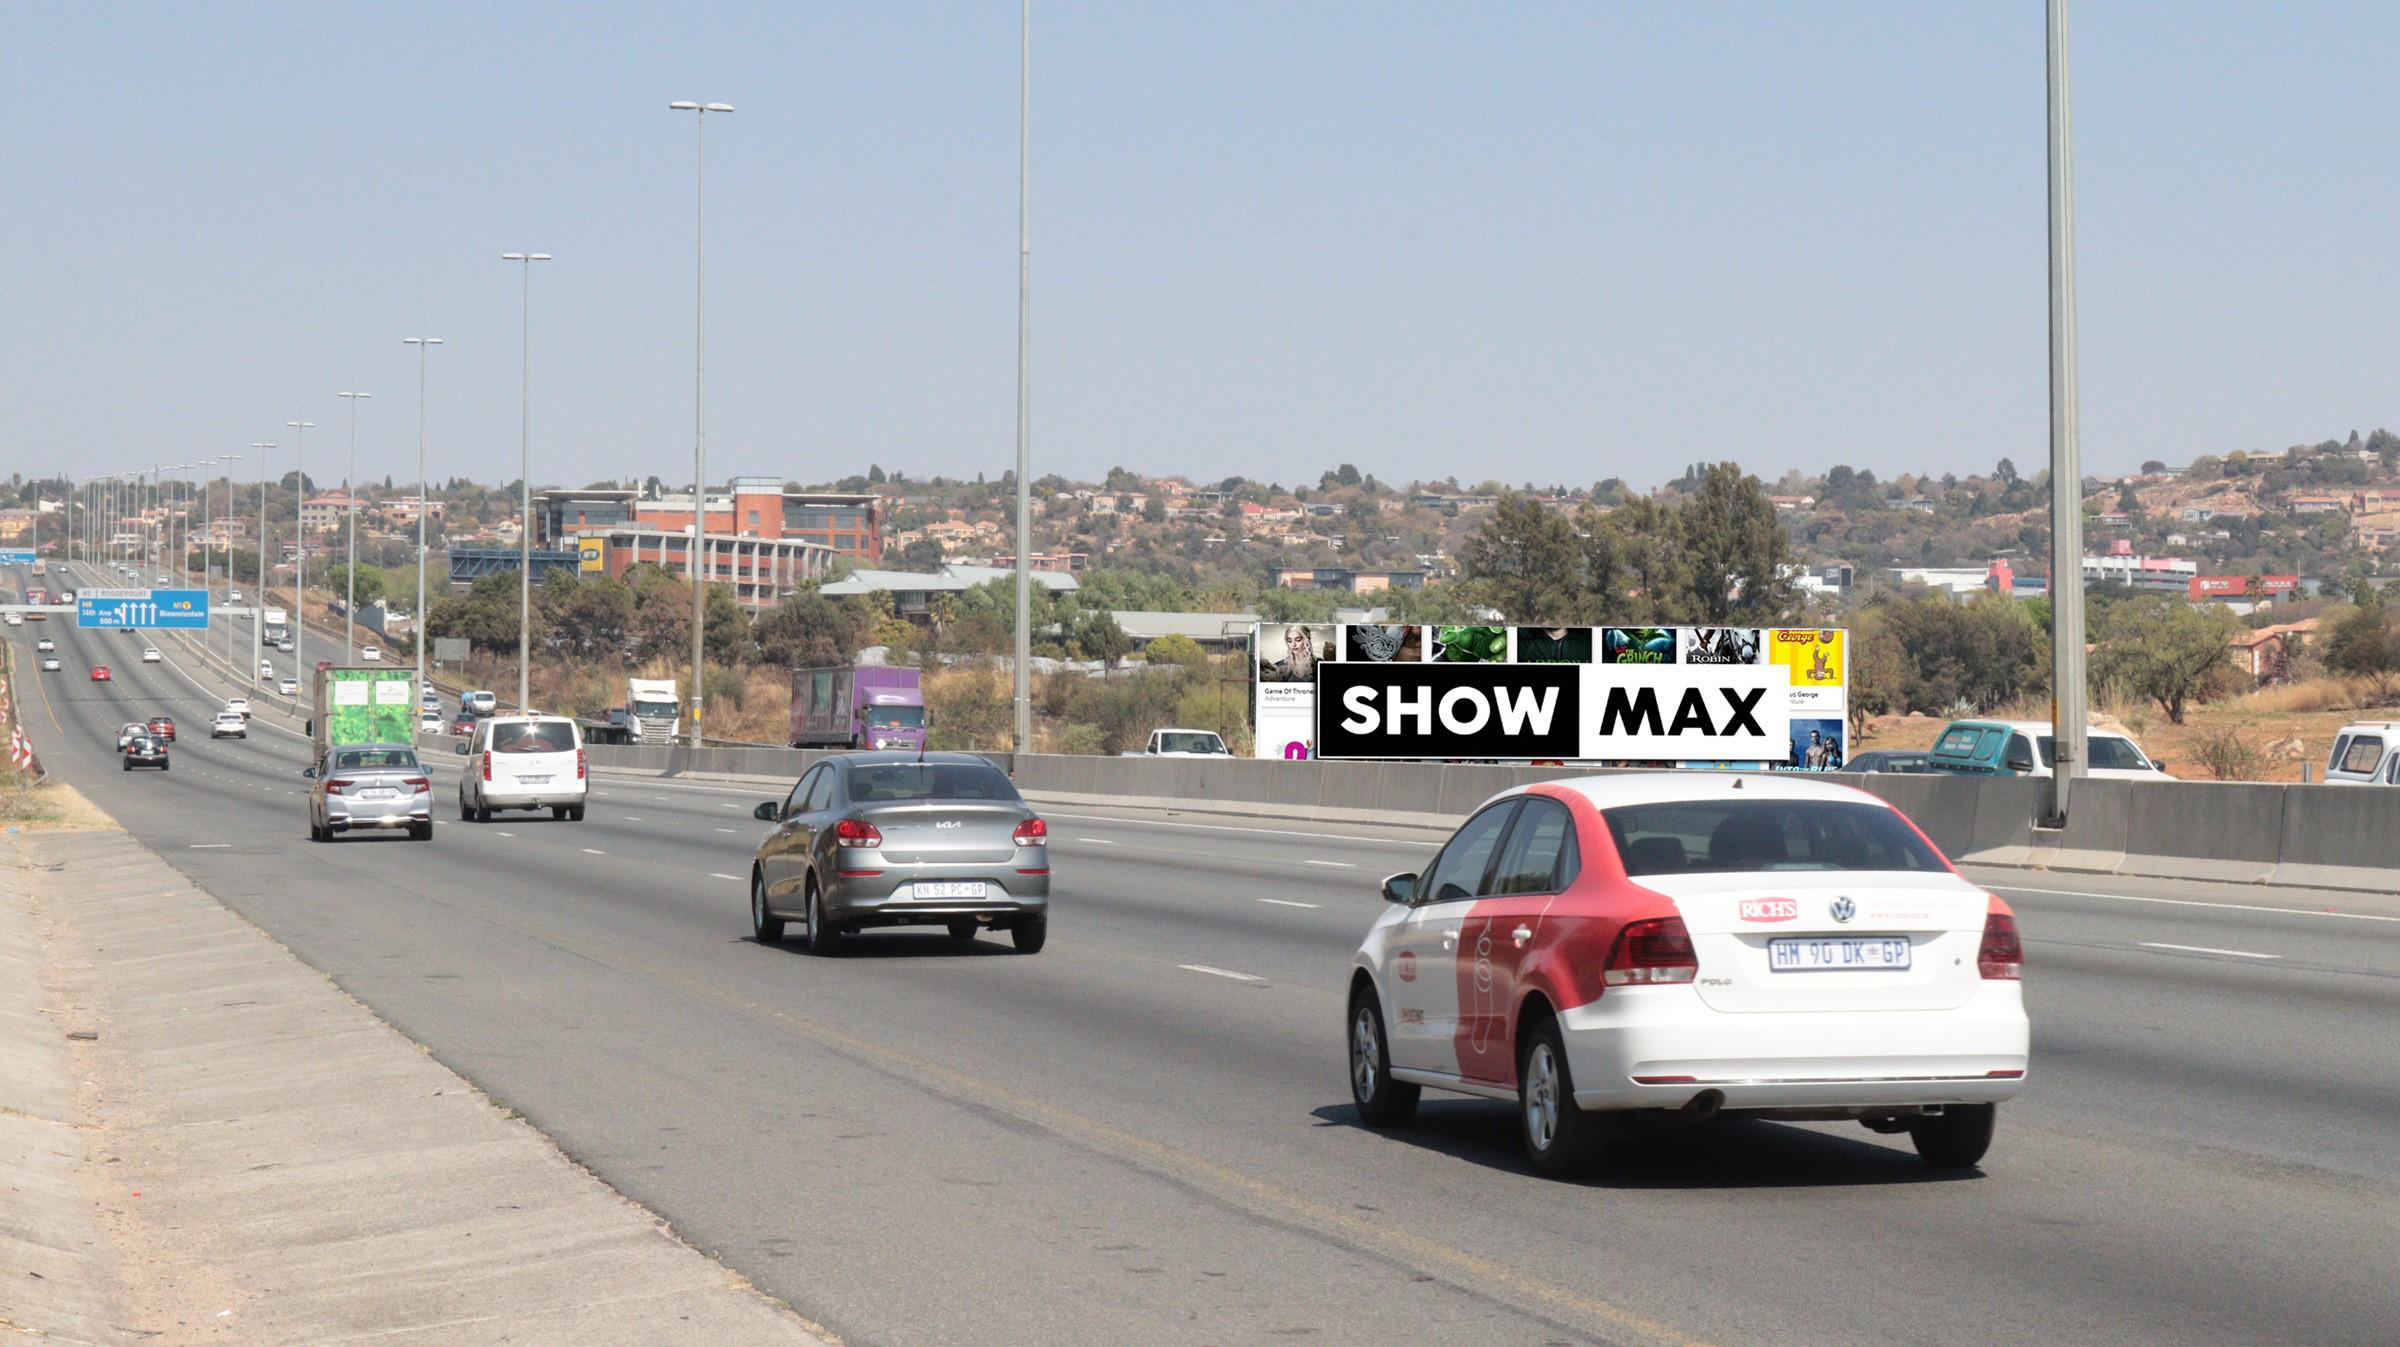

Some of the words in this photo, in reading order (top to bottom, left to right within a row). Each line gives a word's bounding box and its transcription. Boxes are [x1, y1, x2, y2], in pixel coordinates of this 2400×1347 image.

[1616, 652, 1664, 664] GRINCH
[1692, 655, 1731, 663] ROBIN
[1797, 691, 1818, 699] George
[1340, 685, 1560, 735] SHOW
[1598, 686, 1767, 736] MAX
[971, 884, 983, 895] GP
[1776, 943, 1800, 965] HM
[1842, 942, 1865, 964] DK
[1881, 941, 1904, 963] GP
